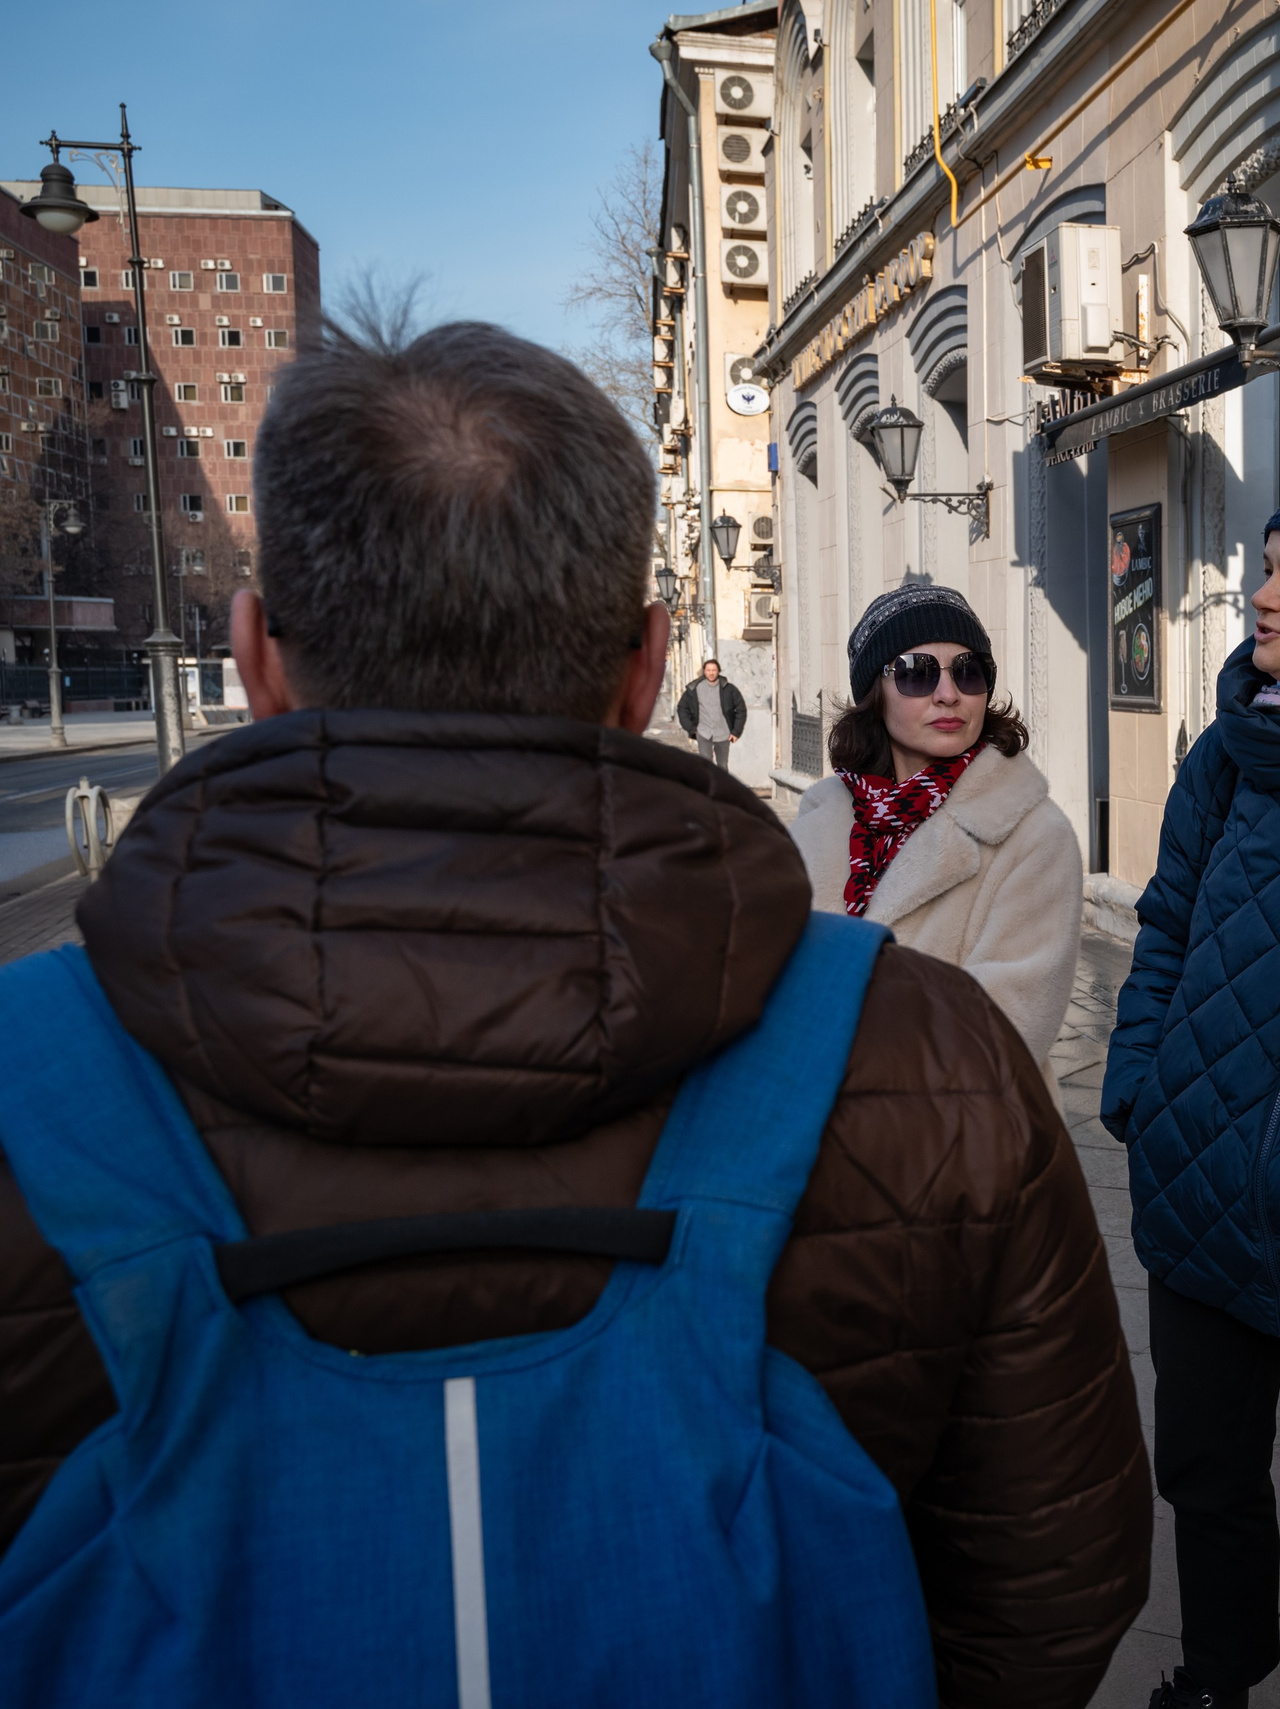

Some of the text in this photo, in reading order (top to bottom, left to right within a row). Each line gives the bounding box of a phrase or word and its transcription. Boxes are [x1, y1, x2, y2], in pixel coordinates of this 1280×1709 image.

[875, 231, 935, 315] ФАРФОР
[1091, 368, 1220, 436] LAMBIC BRASSERIE
[1114, 576, 1153, 625] НОВОЕ МЕНЮ
